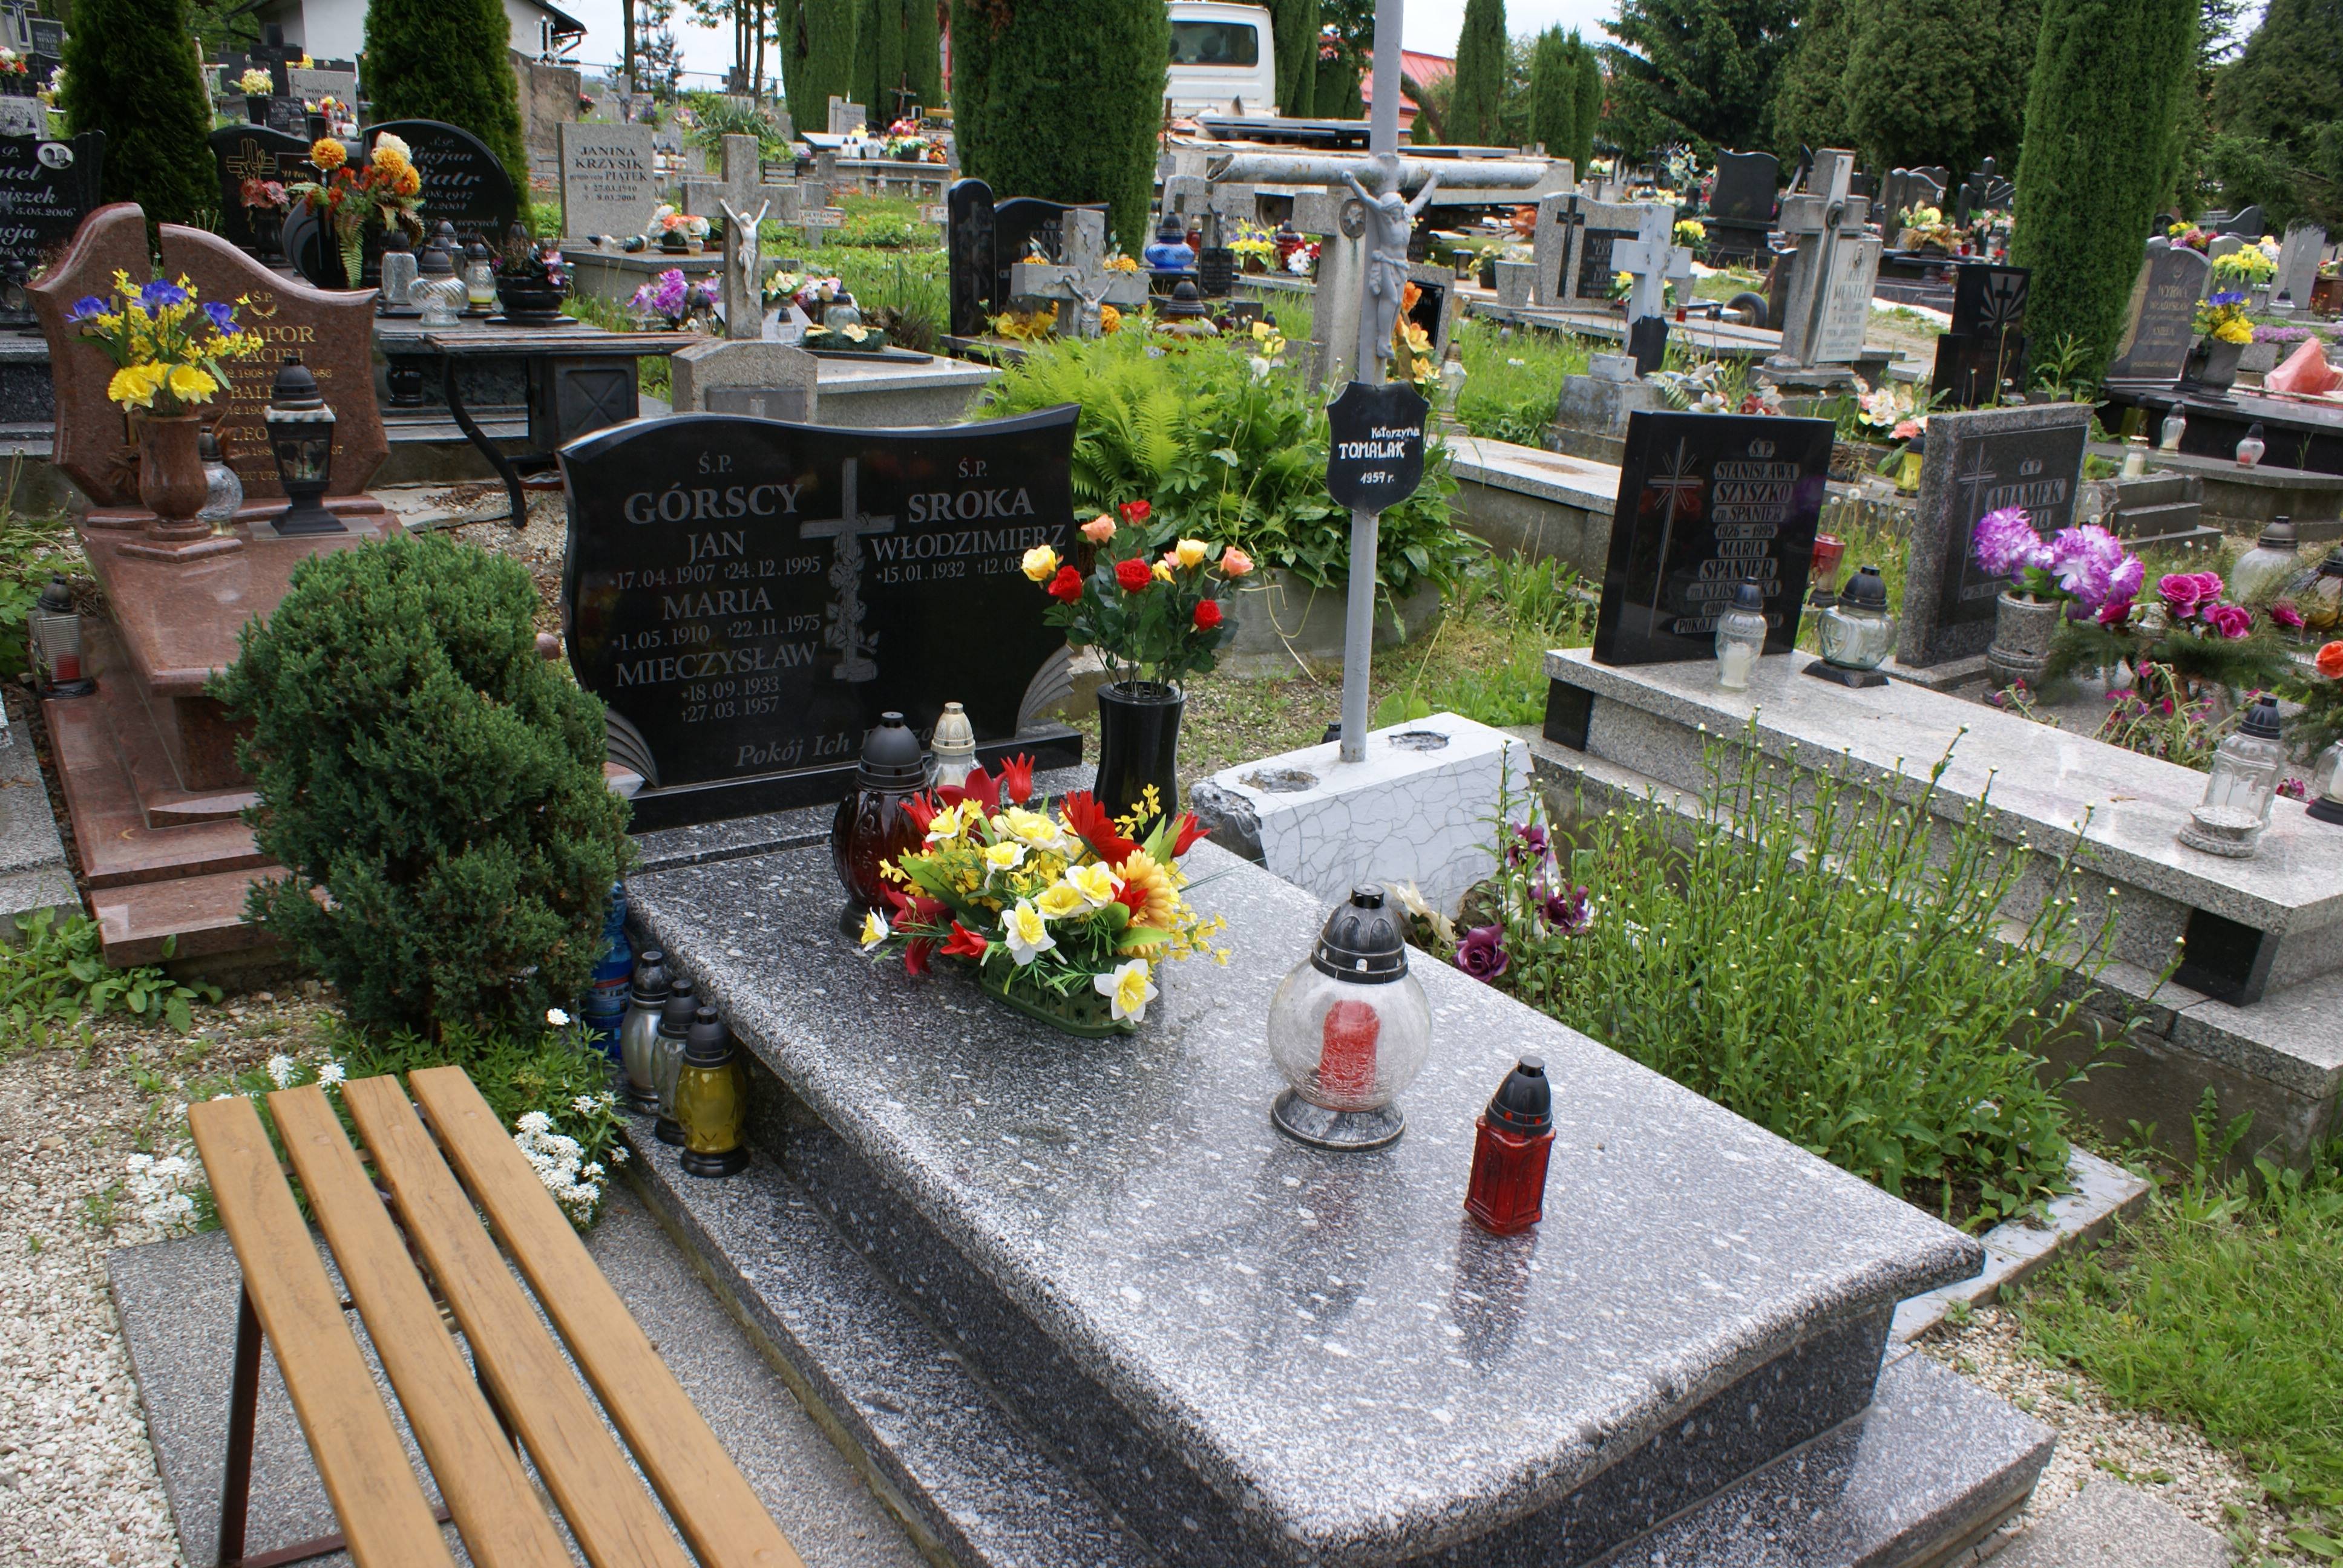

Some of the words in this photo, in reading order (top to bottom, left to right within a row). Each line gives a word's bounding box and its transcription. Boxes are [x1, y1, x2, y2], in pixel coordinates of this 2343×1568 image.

[581, 146, 636, 155] JANINA
[0, 164, 42, 180] tel
[575, 158, 644, 169] KRZYSIK
[419, 165, 484, 186] iatr
[605, 172, 647, 182] PIĄTEK
[0, 223, 39, 245] cja
[241, 325, 316, 342] APOR
[1339, 441, 1404, 460] TOMALAK
[698, 451, 733, 475] Ś.P.
[958, 457, 988, 478] Ś.P.
[1716, 462, 1794, 480] STANISŁAWA
[1716, 482, 1789, 503] SZYSZKO
[624, 482, 804, 525] GÓRSCY
[908, 488, 1035, 524] SROKA
[1729, 505, 1782, 521] SPANIER
[1717, 525, 1740, 538] 1926
[687, 531, 746, 565] JAN
[870, 524, 1066, 562] WŁODZIMIERZ
[1721, 541, 1763, 557] MARIA
[1703, 560, 1772, 580] SPANIER
[662, 586, 774, 621] MARIA
[615, 640, 819, 688] MIECZYSŁAW
[734, 739, 804, 768] Pokój
[812, 731, 850, 757] Ich
